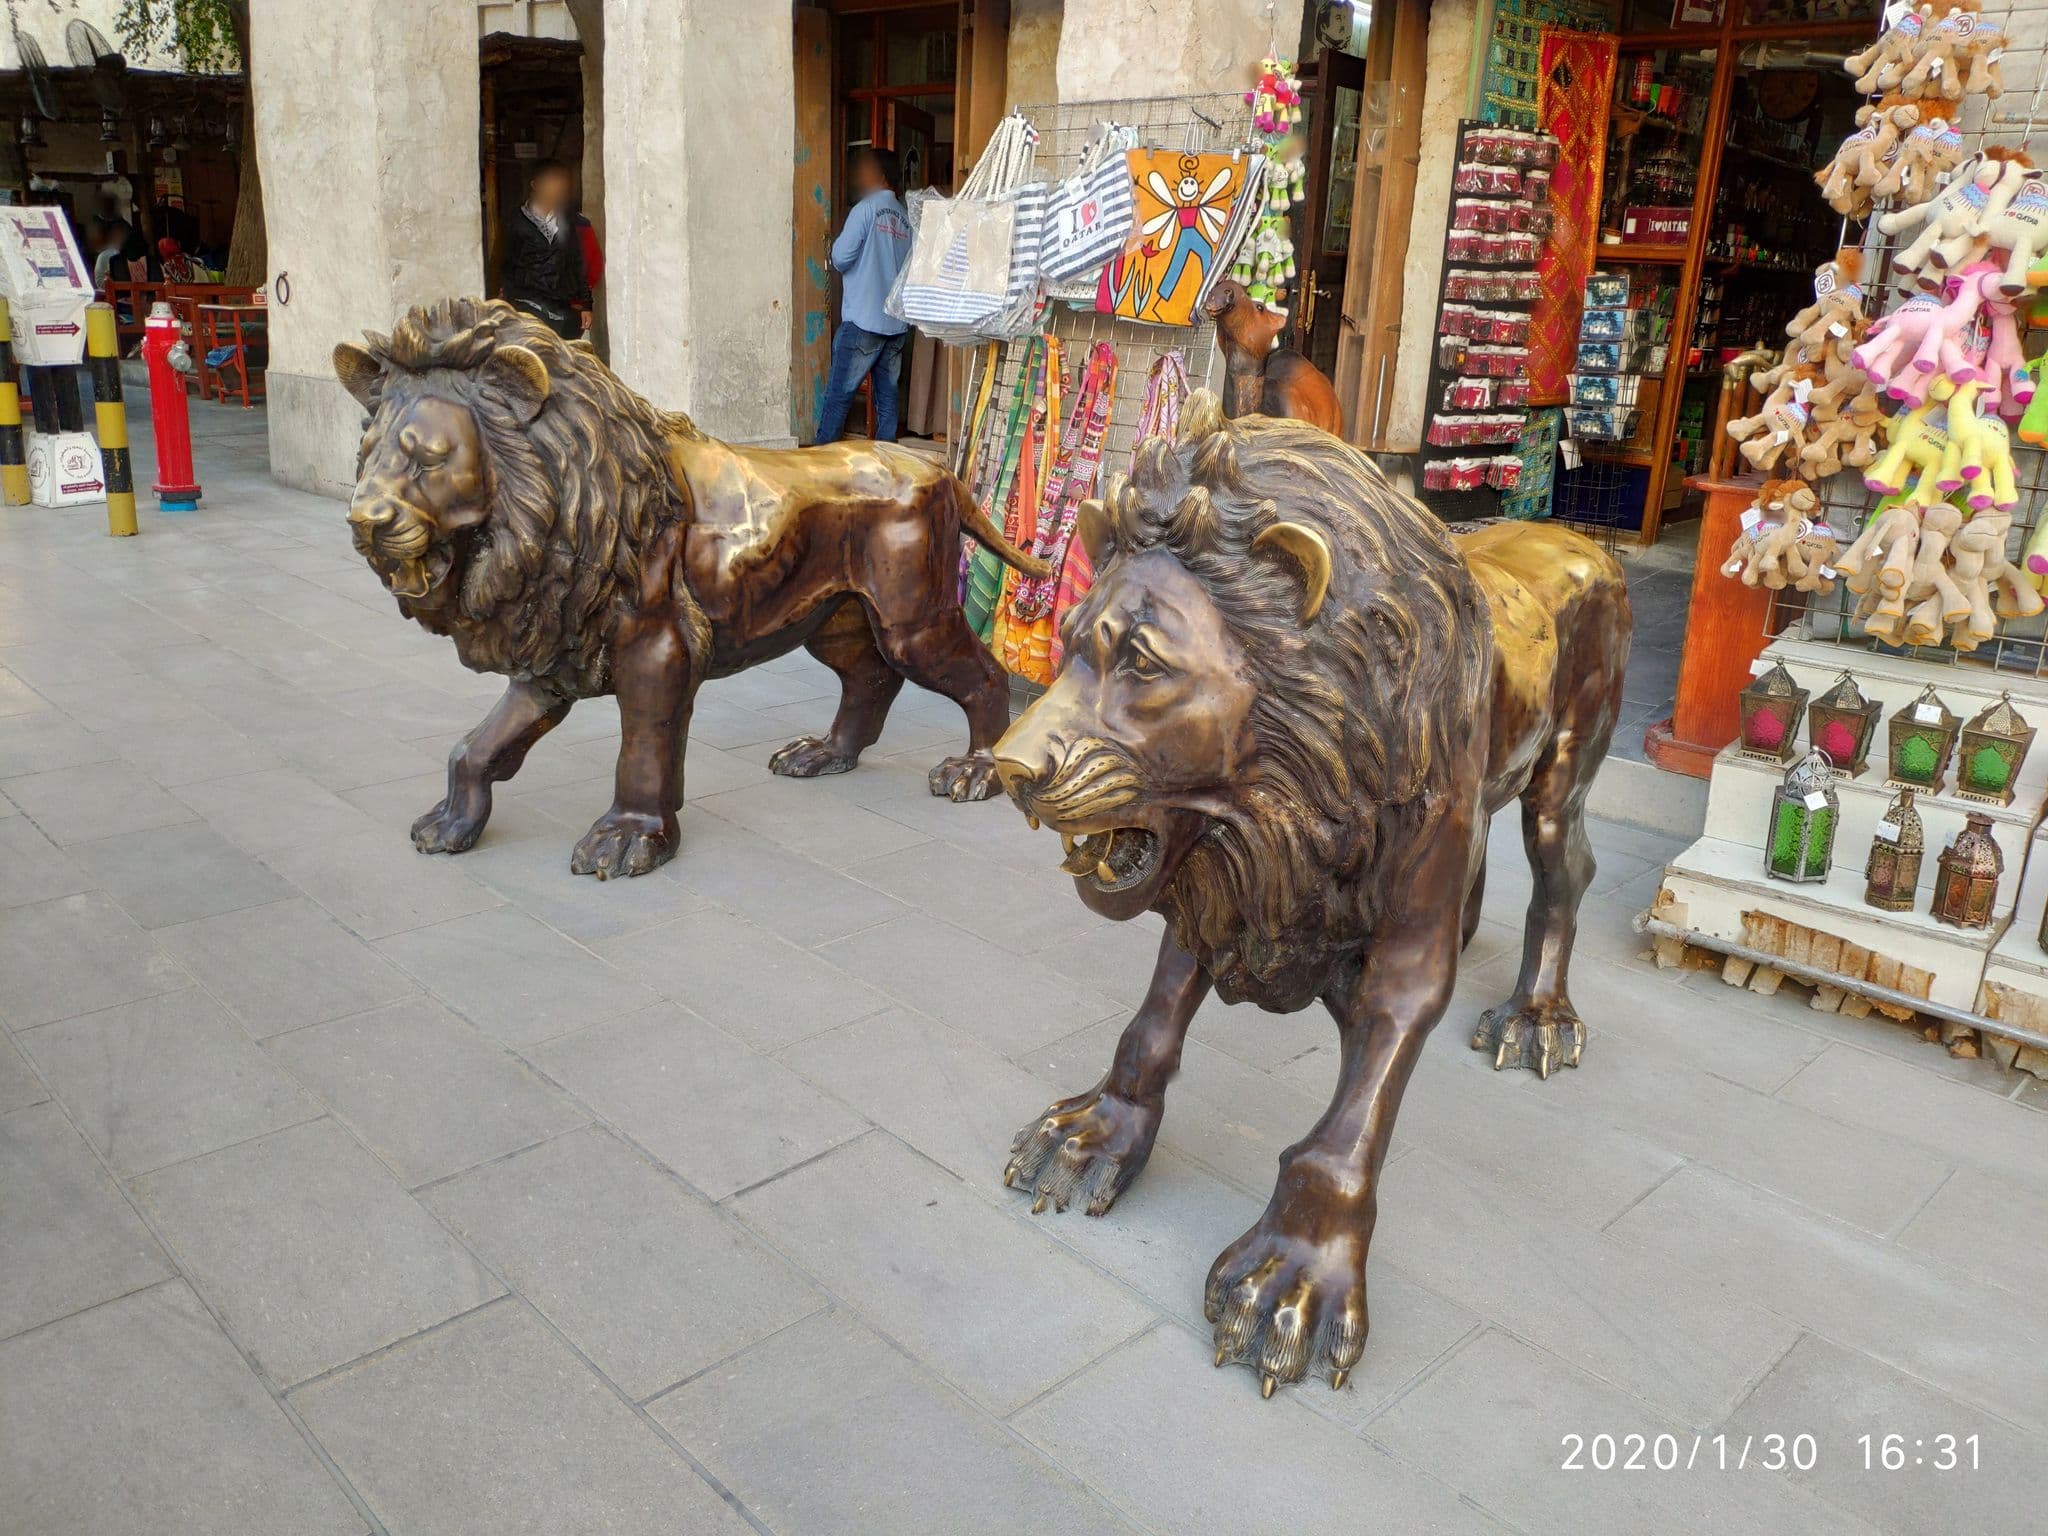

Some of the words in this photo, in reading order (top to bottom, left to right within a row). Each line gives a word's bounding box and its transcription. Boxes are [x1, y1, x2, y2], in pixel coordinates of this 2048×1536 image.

[1071, 208, 1079, 234] I
[1651, 220, 1656, 231] I
[1662, 220, 1688, 232] QATAR
[2016, 213, 2039, 226] QATAR
[1063, 221, 1101, 248] QATAR
[1928, 437, 1945, 451] QATAR
